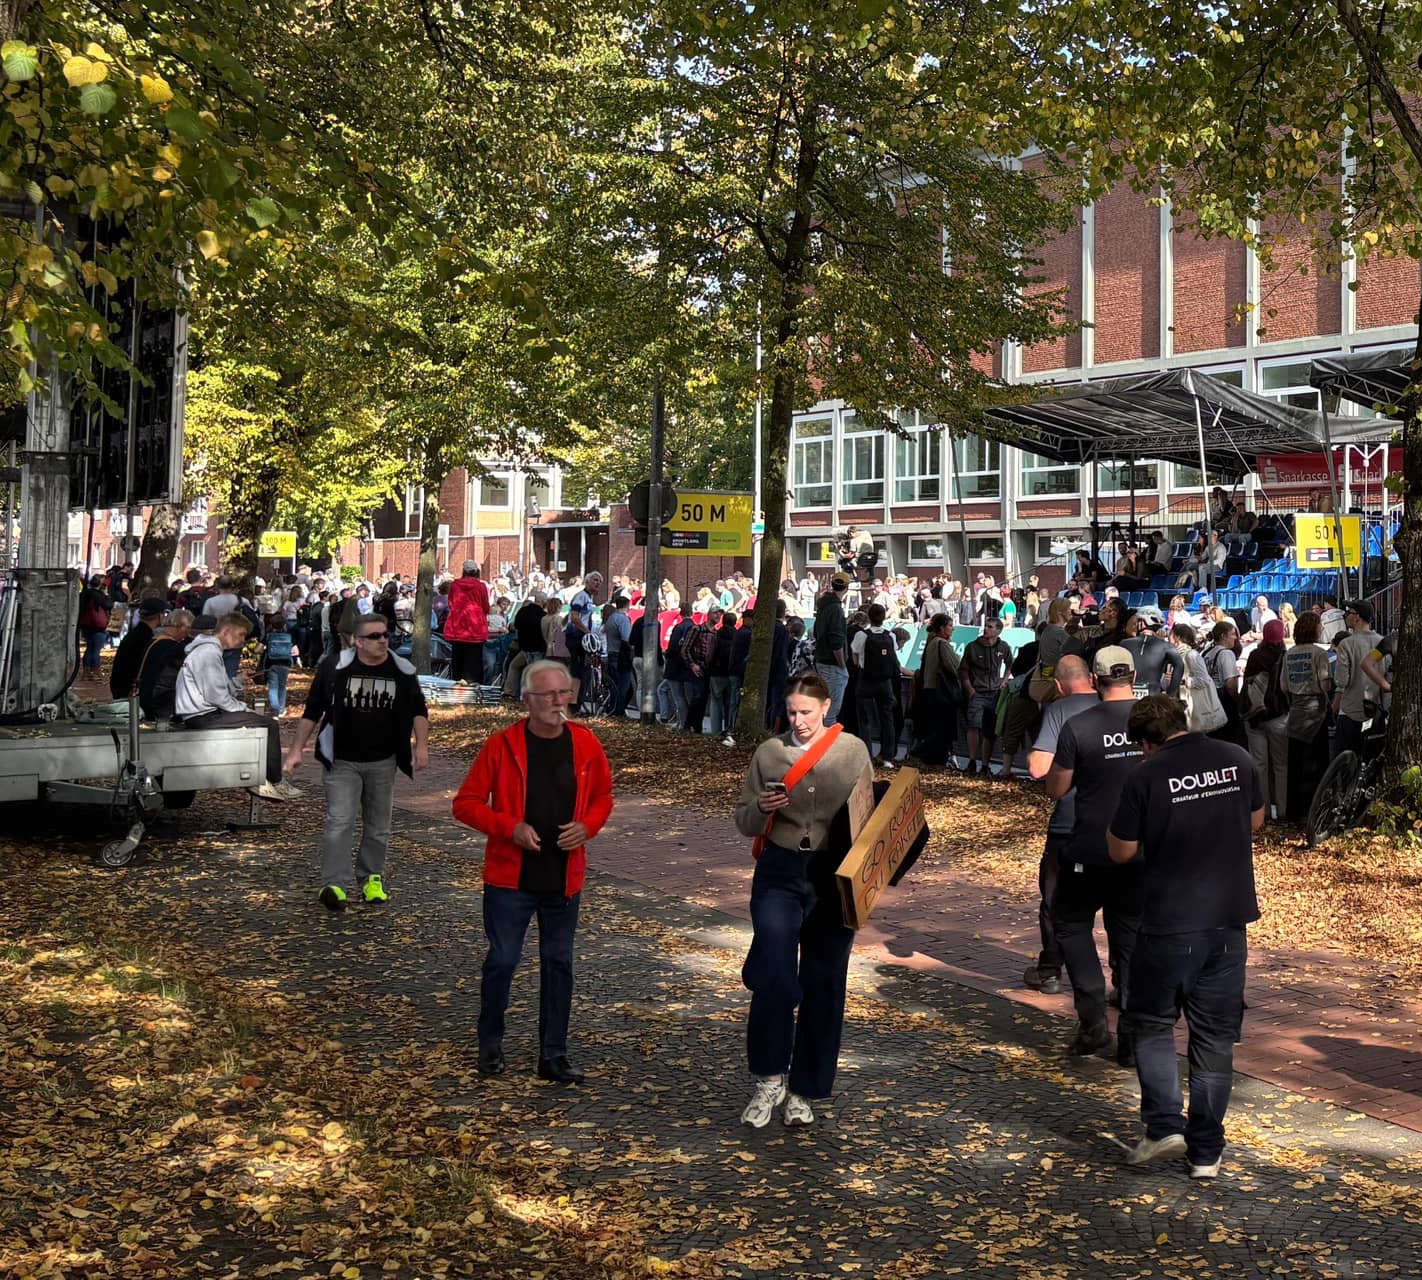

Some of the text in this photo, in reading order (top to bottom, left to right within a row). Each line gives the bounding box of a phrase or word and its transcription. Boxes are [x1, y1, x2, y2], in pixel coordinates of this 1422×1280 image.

[681, 503, 725, 522] 50 M
[1315, 525, 1329, 540] 50
[1168, 766, 1238, 793] DOUBLET
